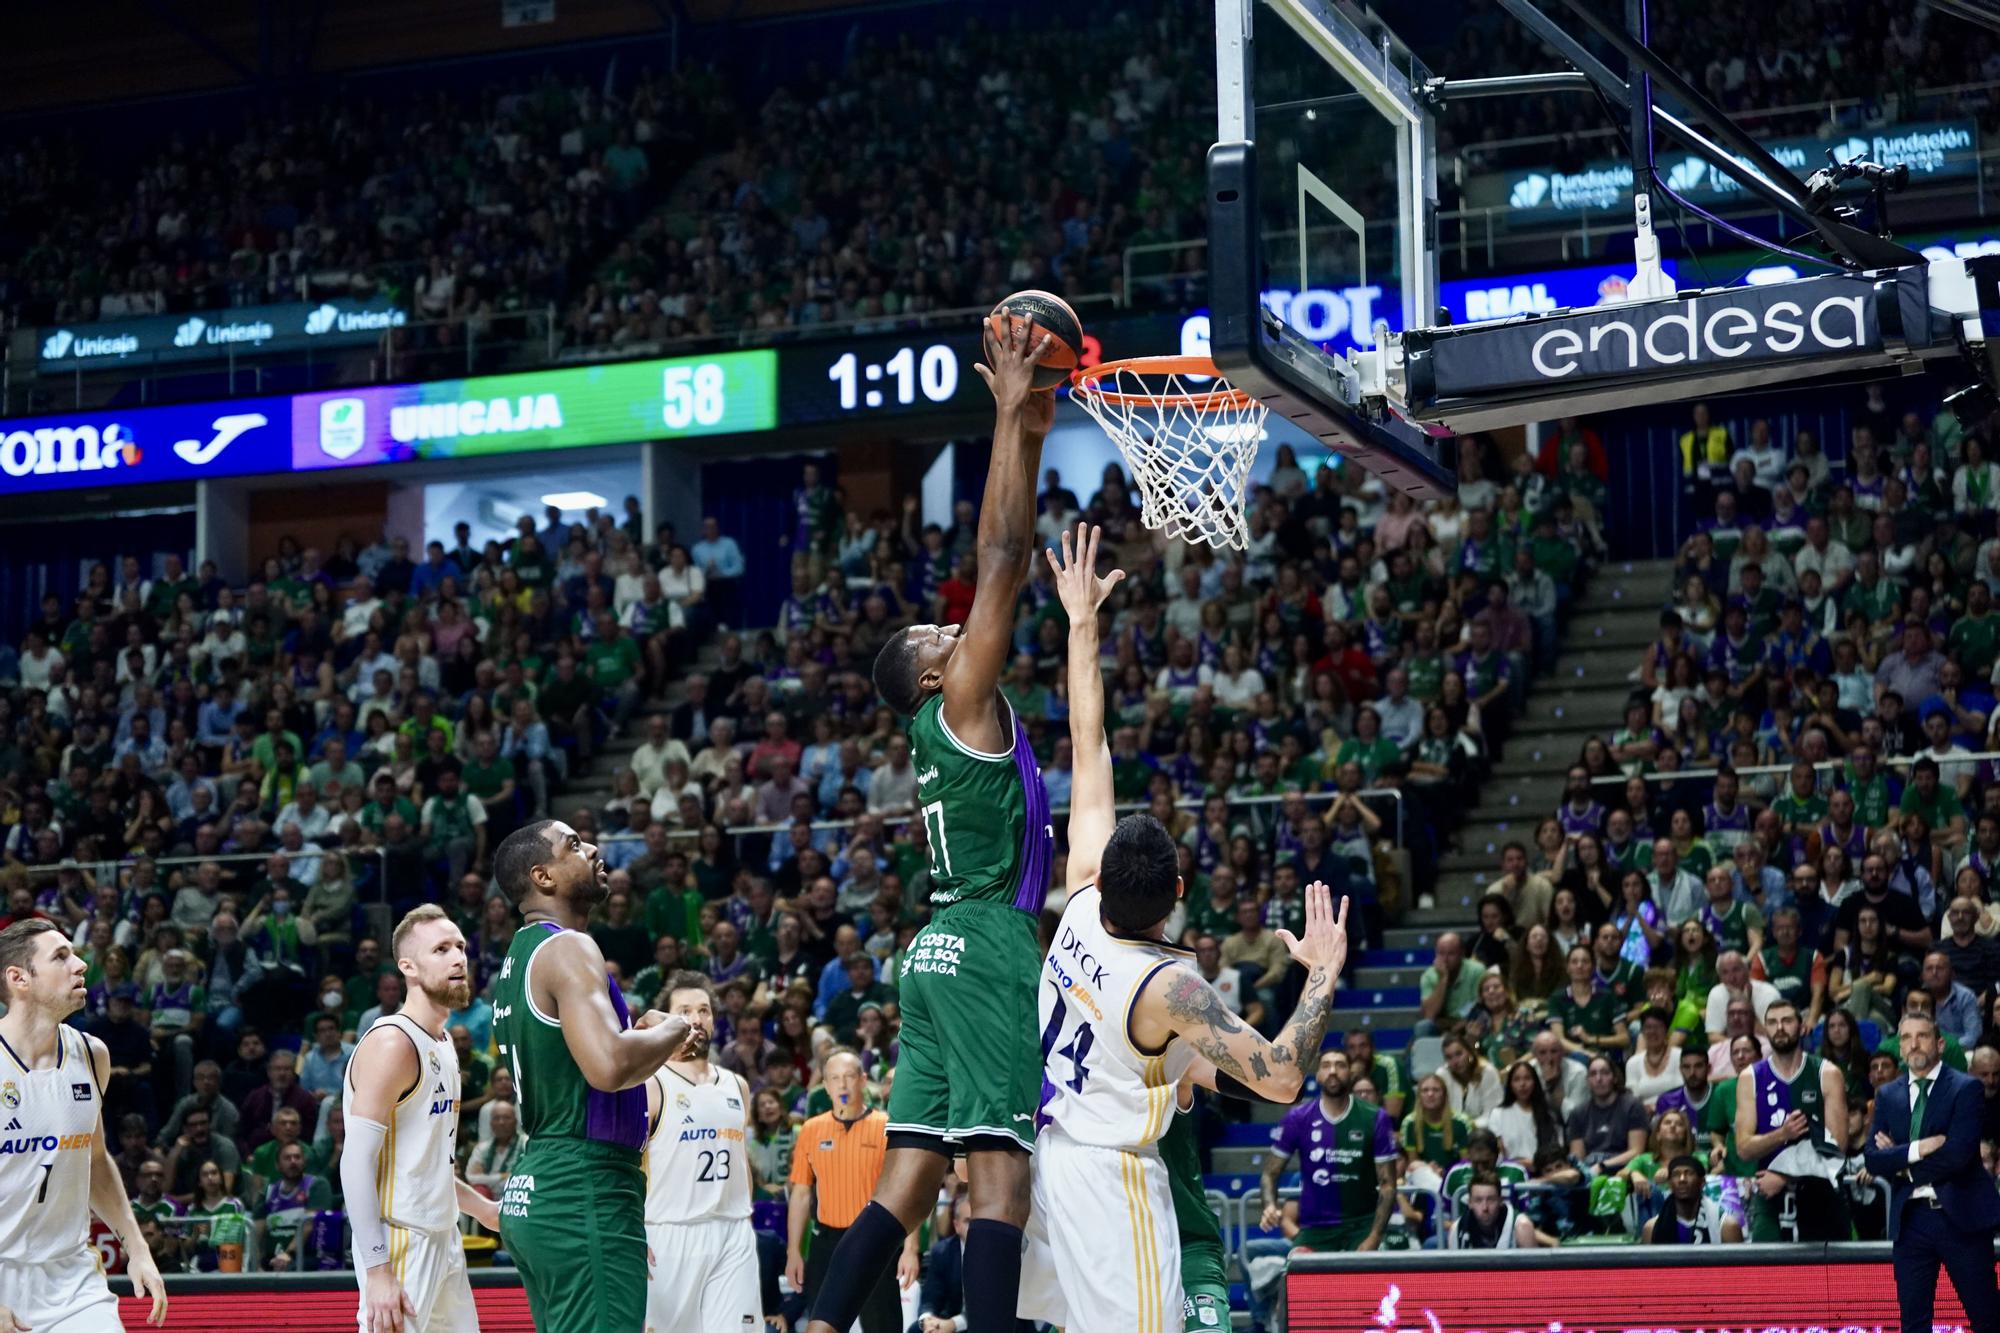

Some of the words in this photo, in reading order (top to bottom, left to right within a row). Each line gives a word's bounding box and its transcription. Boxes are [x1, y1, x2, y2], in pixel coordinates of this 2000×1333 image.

[1551, 166, 1634, 191] Fundació
[1465, 283, 1557, 321] REAL
[74, 333, 138, 358] Unicaja
[205, 321, 273, 347] Unicaja
[1531, 298, 1865, 377] endesa
[828, 344, 959, 409] 1:10
[663, 363, 724, 429] 58
[390, 393, 563, 442] UNICAJA
[0, 423, 142, 476] oma
[915, 948, 932, 960] DEL
[934, 948, 961, 964] SOL
[920, 933, 965, 952] COSTA
[1060, 926, 1110, 992] DECK
[913, 960, 957, 977] MÁLAGA
[0, 1133, 92, 1154] AUTOHER
[696, 1149, 731, 1182] 23
